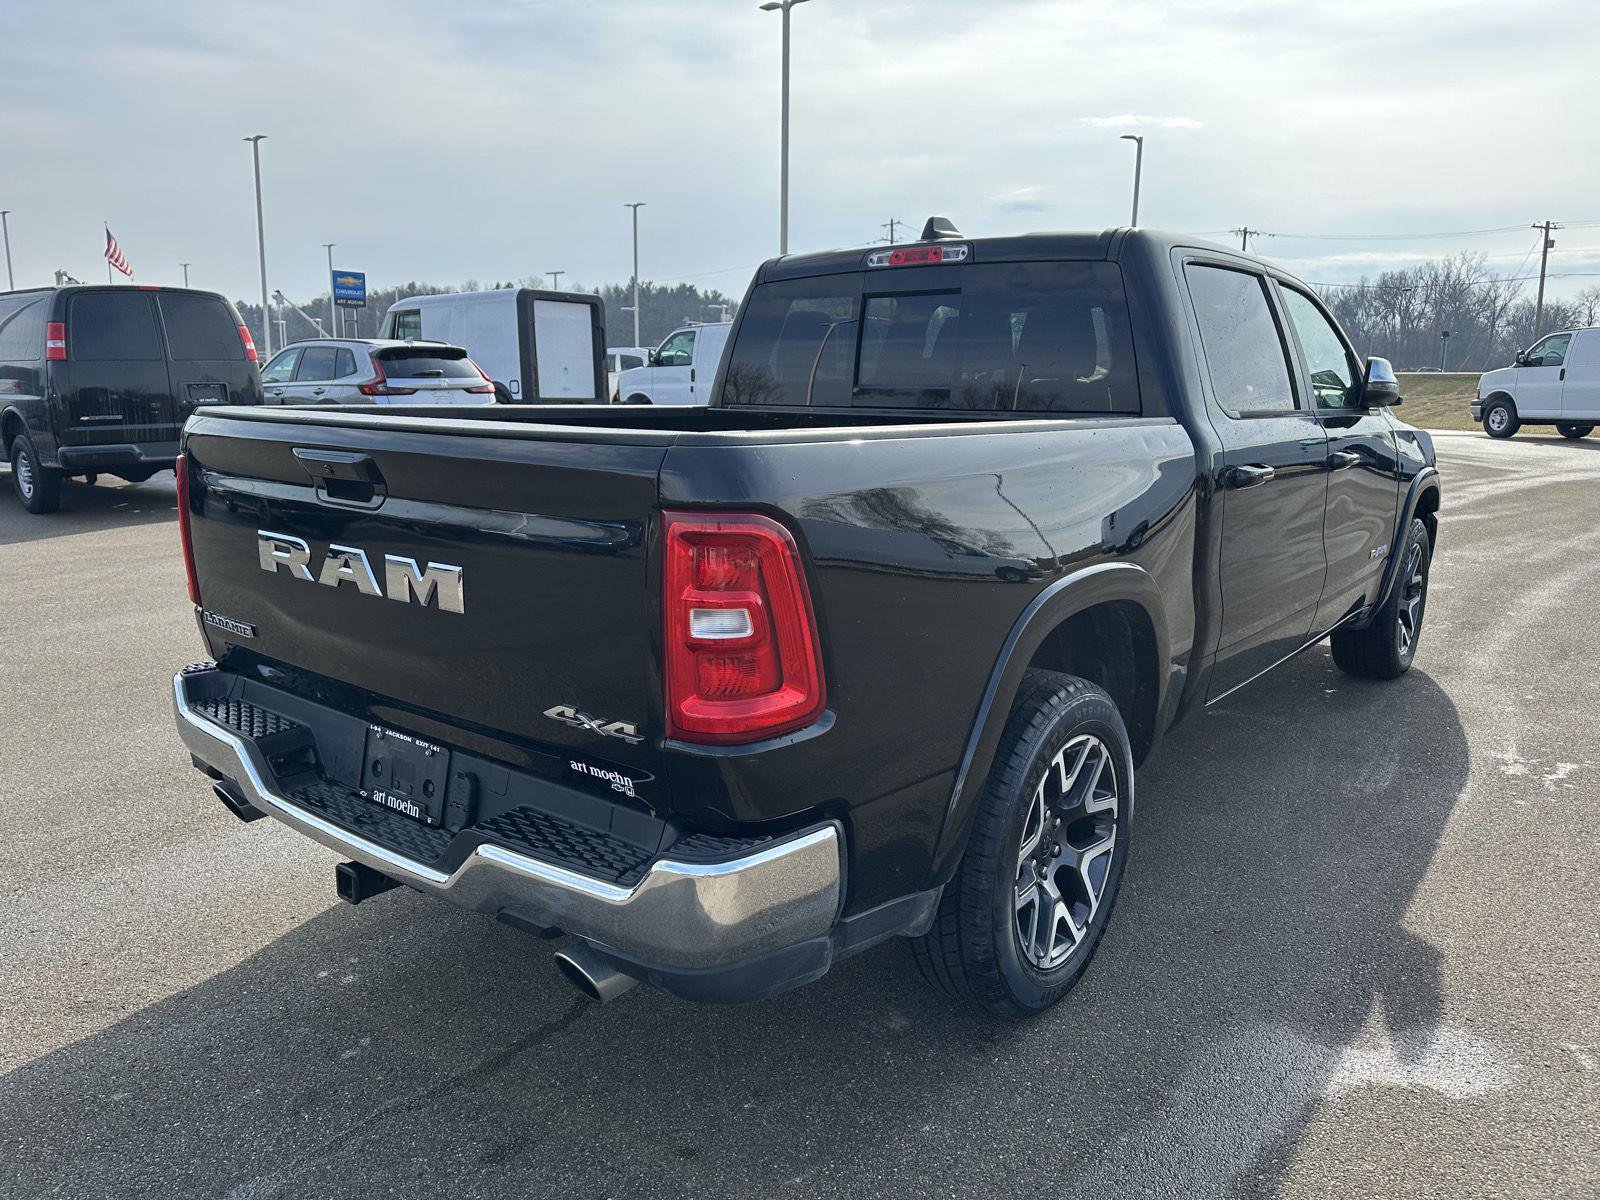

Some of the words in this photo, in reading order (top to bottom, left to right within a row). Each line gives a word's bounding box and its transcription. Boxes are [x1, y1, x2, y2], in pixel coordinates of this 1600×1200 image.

[257, 529, 465, 614] RAM
[385, 729, 412, 742] JACKSON
[415, 739, 429, 749] EXIT
[430, 744, 440, 753] 141
[570, 760, 588, 773] art
[589, 765, 633, 787] moehn
[373, 790, 386, 804] art
[387, 796, 419, 818] moehn
